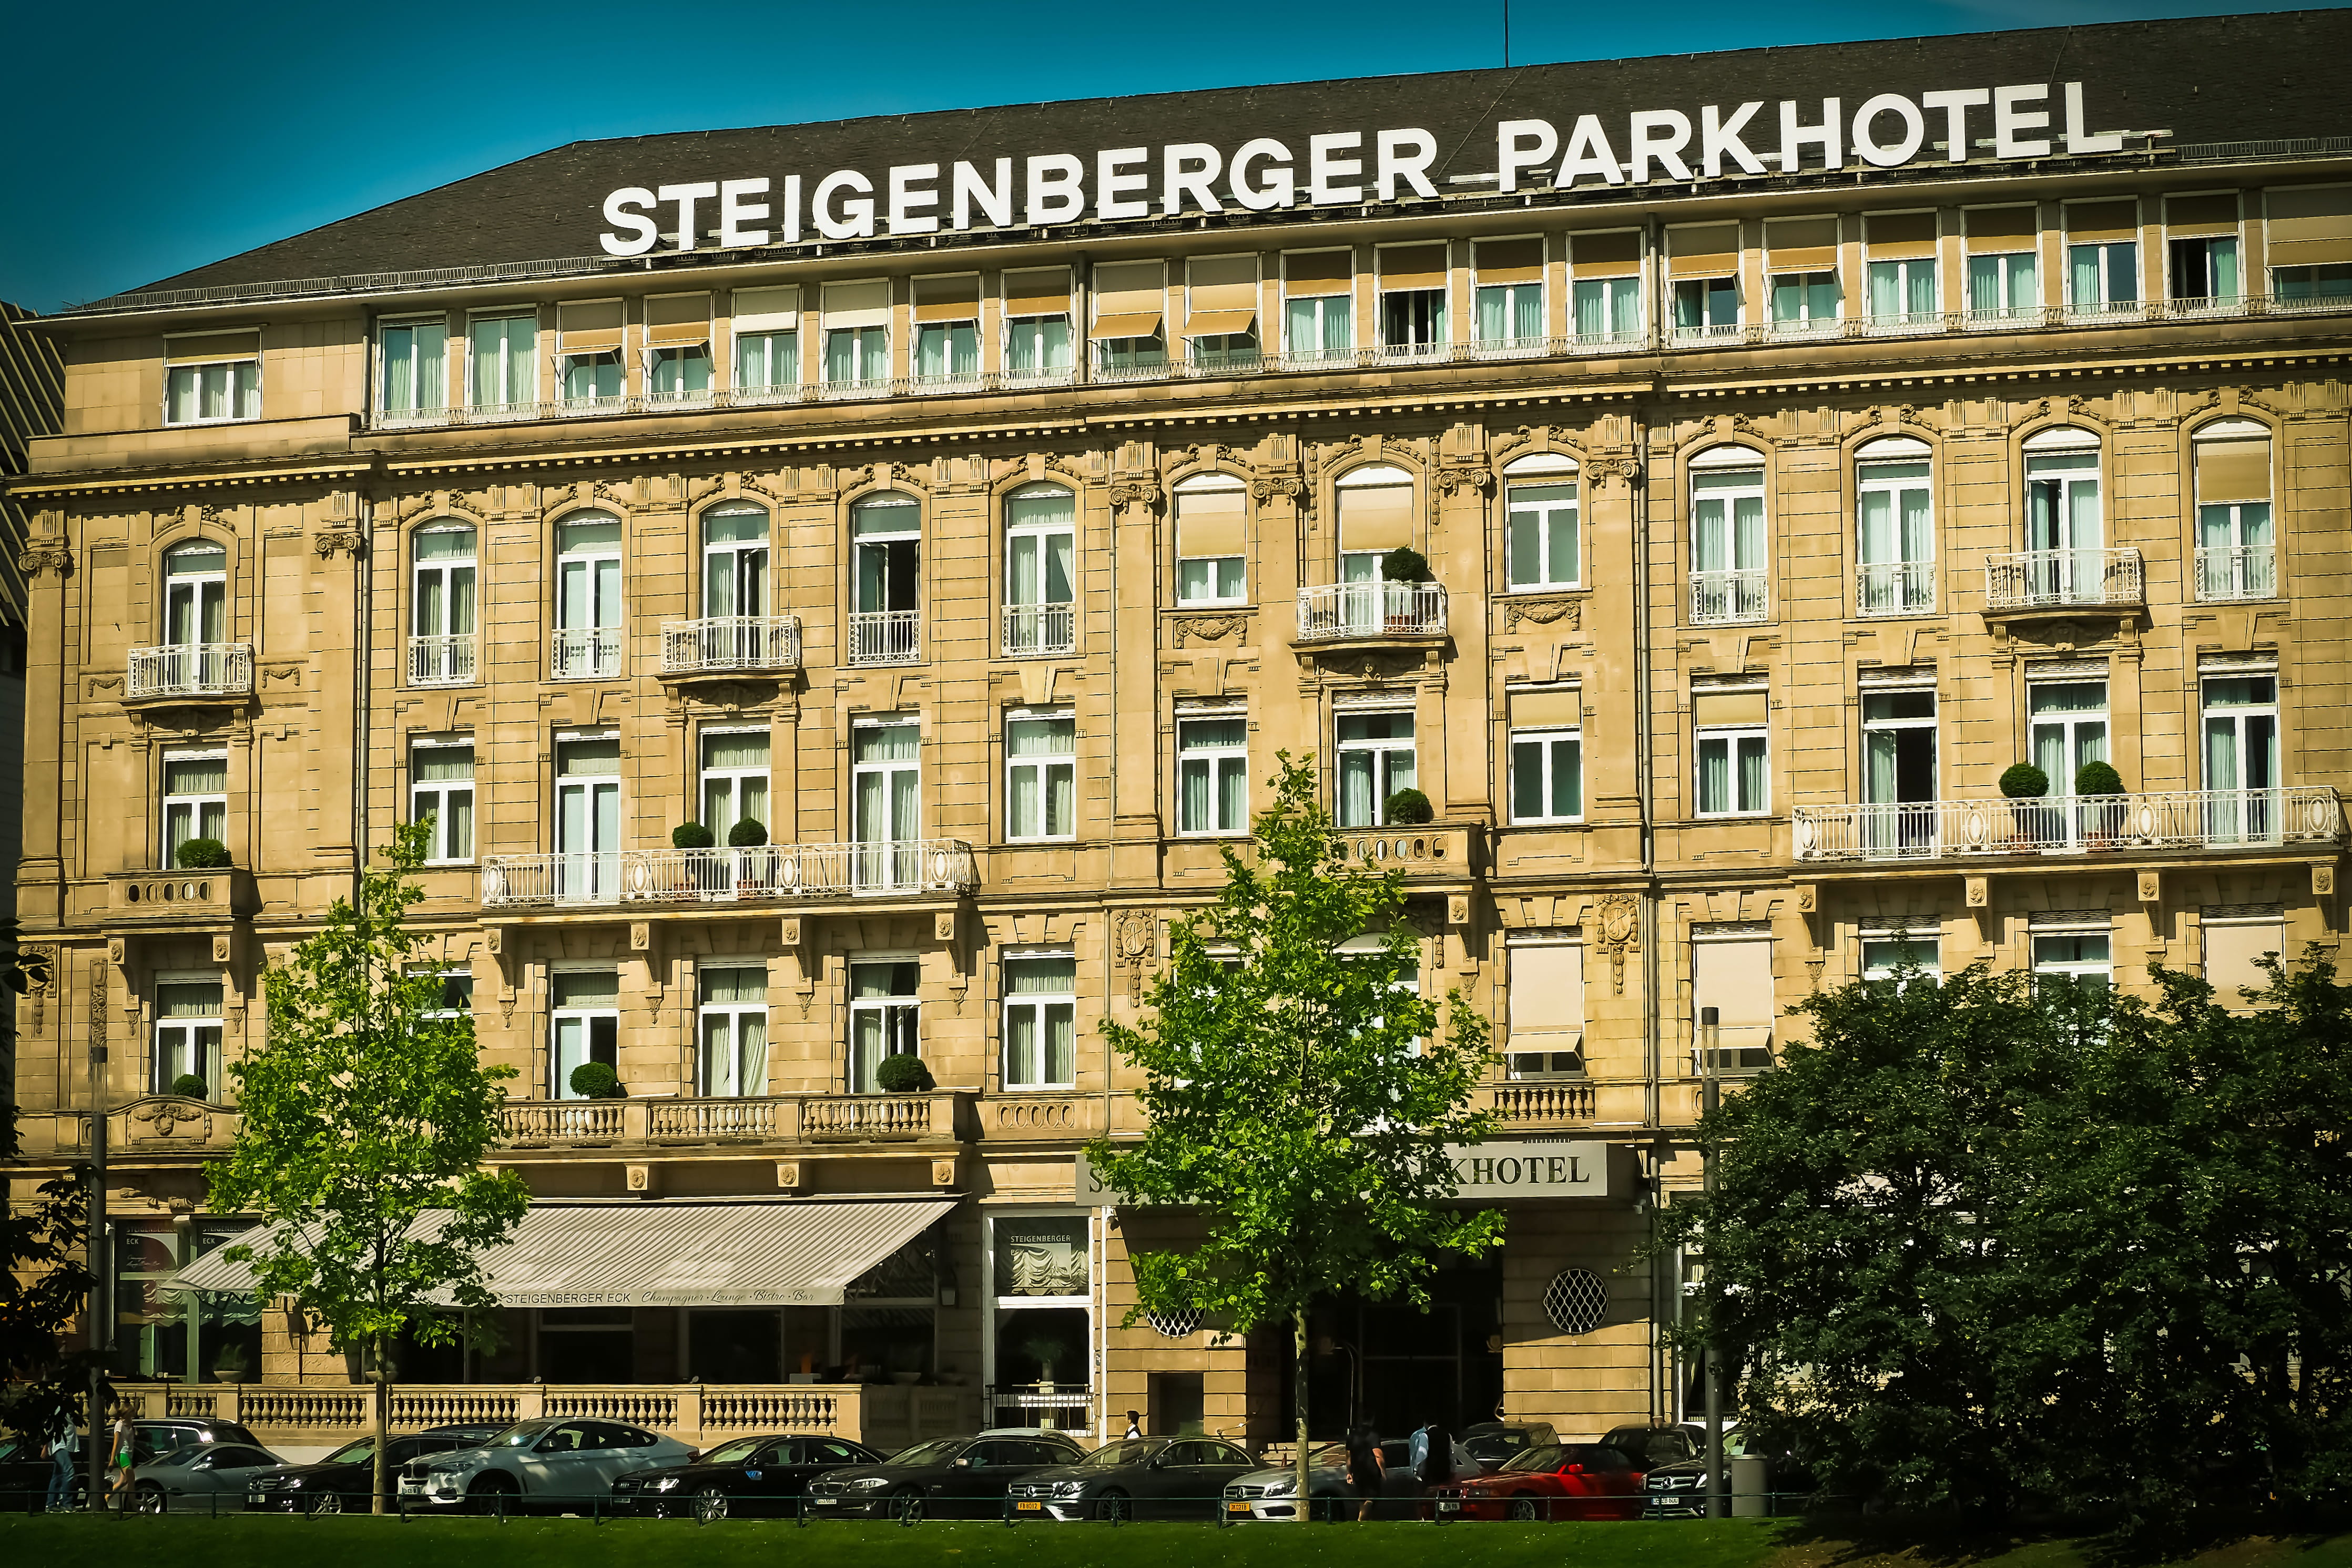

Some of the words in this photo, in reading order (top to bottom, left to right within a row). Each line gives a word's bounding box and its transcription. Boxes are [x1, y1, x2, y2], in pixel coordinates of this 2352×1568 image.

[599, 127, 1441, 257] STEIGENBERGER
[1498, 82, 2123, 193] PARKHOTEL
[1403, 1156, 1590, 1185] KHOTEL
[506, 1293, 603, 1304] STEIGENBERGER
[607, 1292, 631, 1302] ECK
[641, 1290, 704, 1306] Champagner
[710, 1290, 745, 1304] Lounge
[754, 1289, 785, 1300] Bistro
[792, 1289, 814, 1301] Bar
